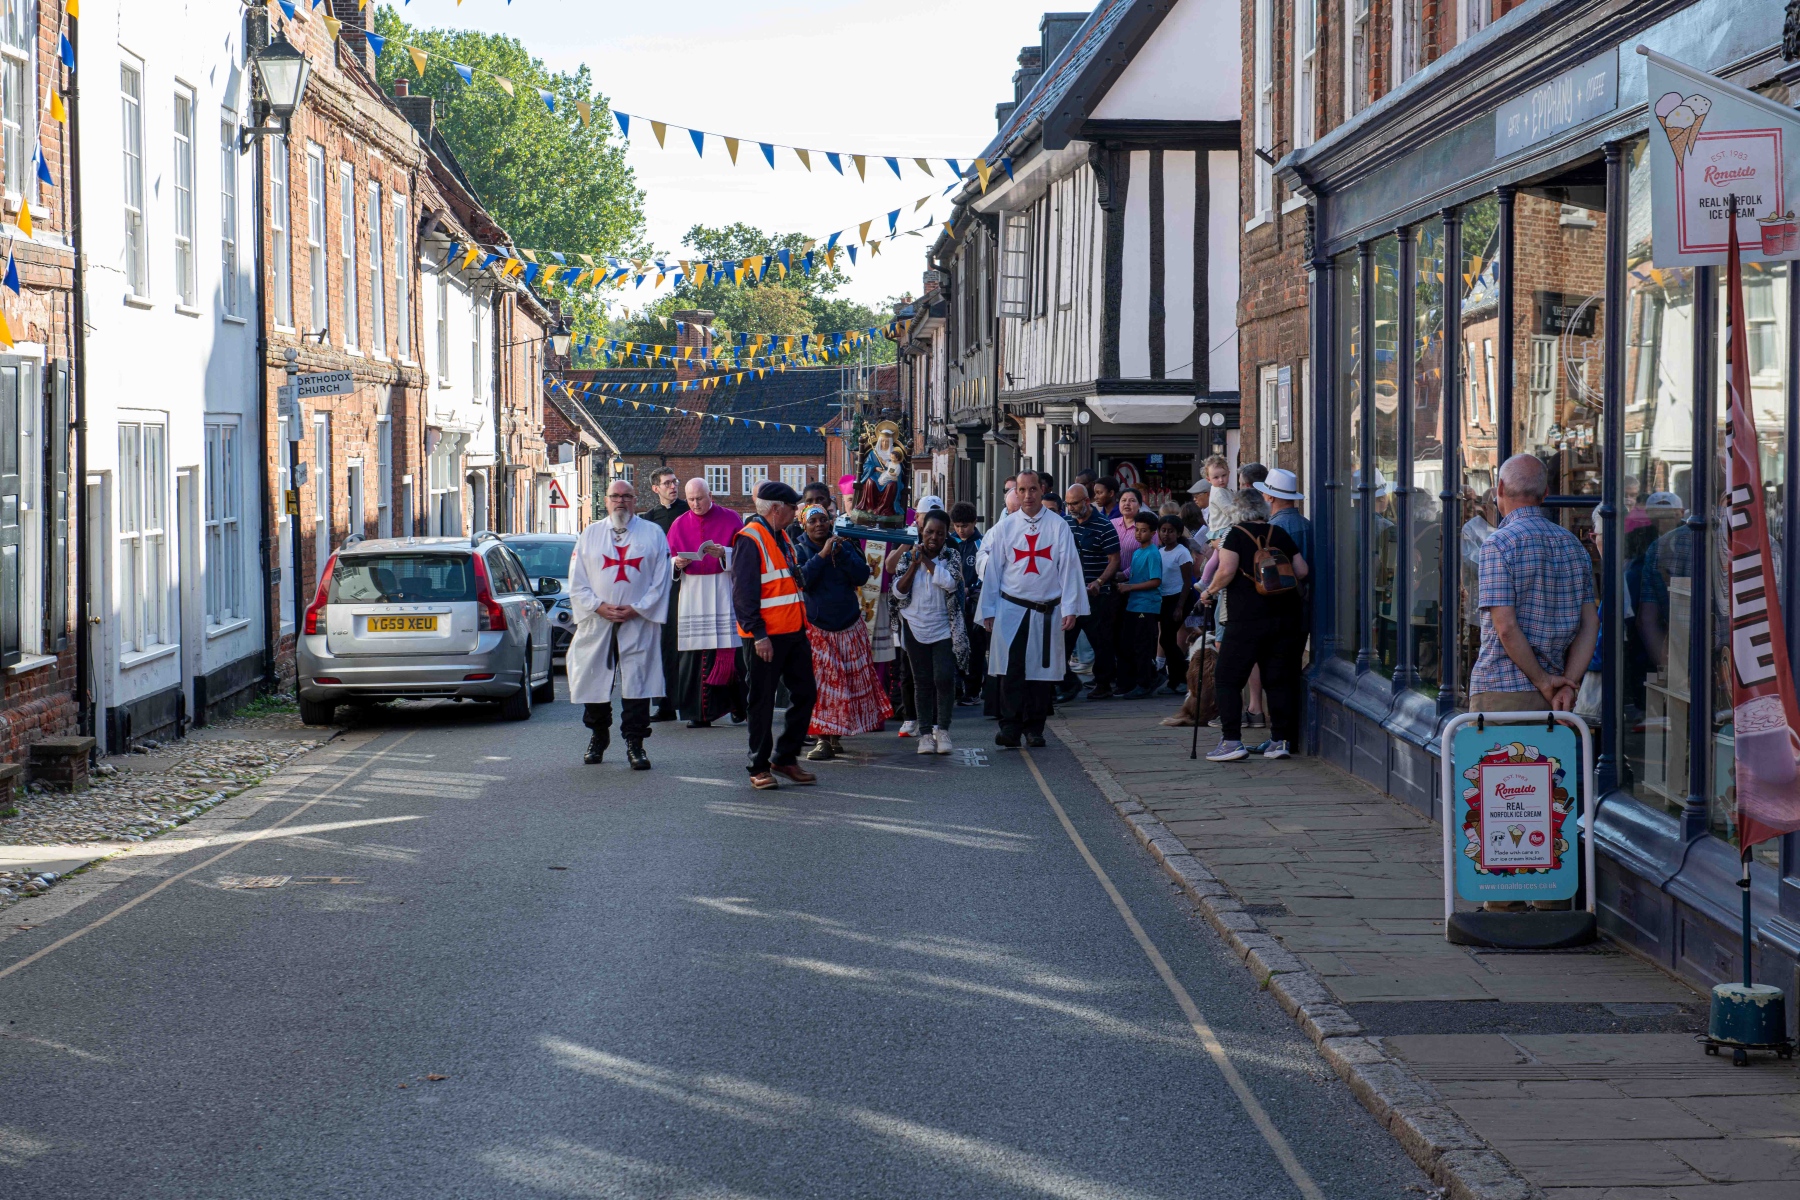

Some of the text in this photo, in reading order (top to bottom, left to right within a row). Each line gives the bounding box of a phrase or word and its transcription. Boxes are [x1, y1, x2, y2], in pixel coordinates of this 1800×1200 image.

[1532, 77, 1573, 140] EPIPHANY
[1730, 150, 1748, 160] 1983
[1704, 165, 1756, 188] Ronaldo
[1699, 195, 1763, 208] REAL NRFOLK
[1709, 207, 1755, 220] ICE CEAM
[298, 373, 351, 386] ORTHODOX
[298, 384, 340, 395] CHURCH
[372, 617, 433, 630] YG59 XEU
[1495, 783, 1536, 800] Ronaldo
[1506, 802, 1525, 811] REAL
